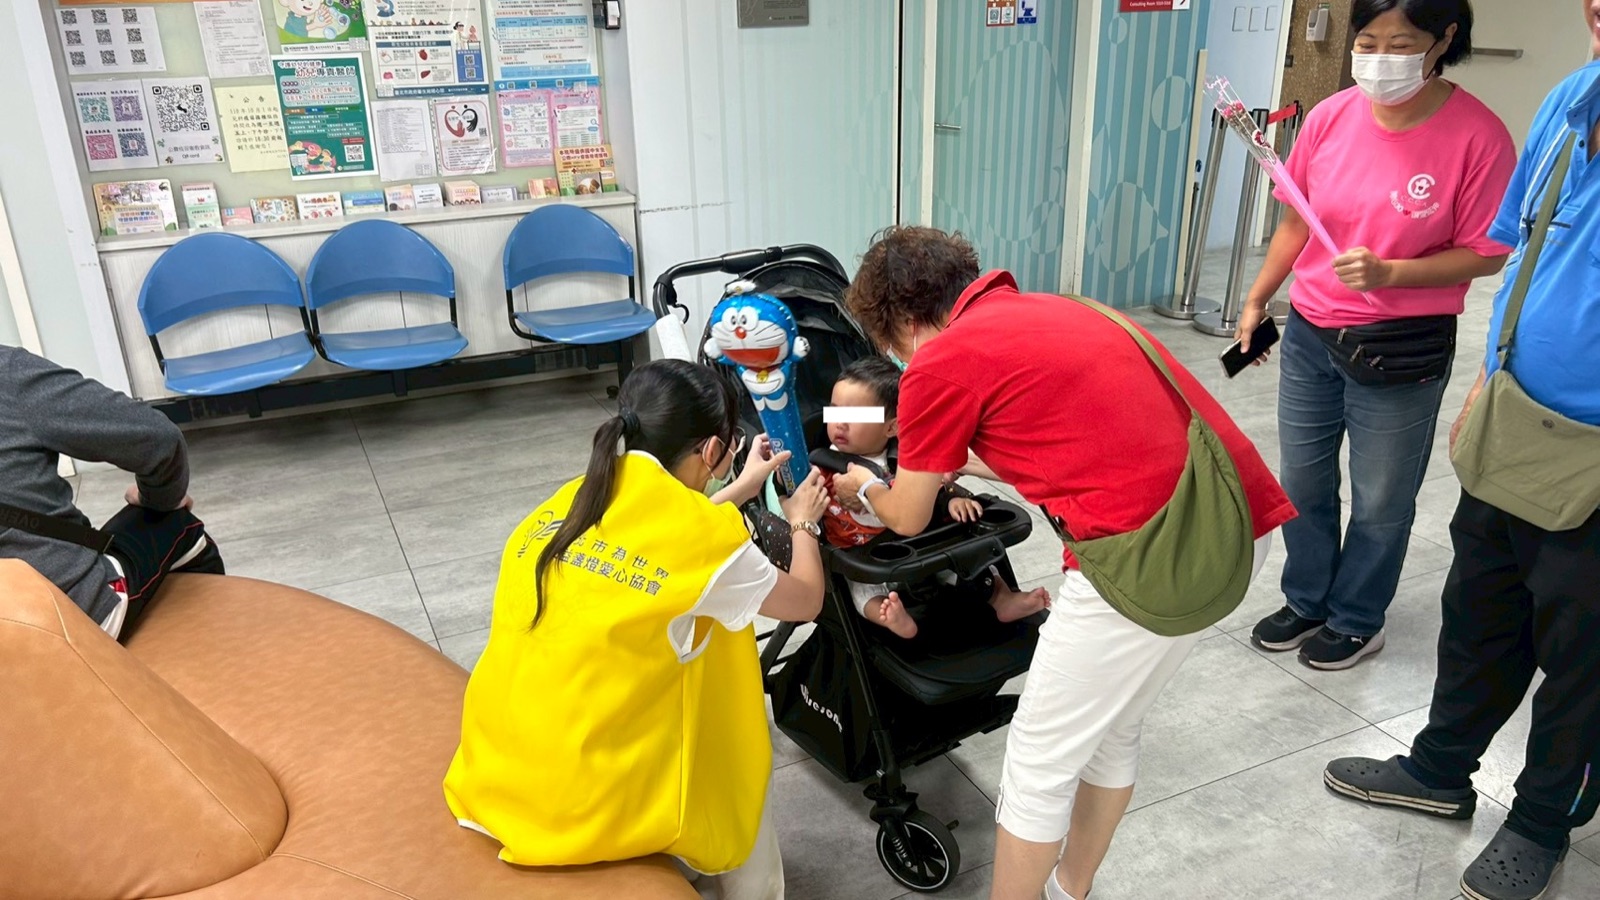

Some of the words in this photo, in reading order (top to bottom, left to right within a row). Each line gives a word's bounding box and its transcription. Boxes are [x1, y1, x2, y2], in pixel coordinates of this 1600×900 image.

[295, 66, 356, 78] 幼兒專責醫師
[243, 95, 265, 103] 公告
